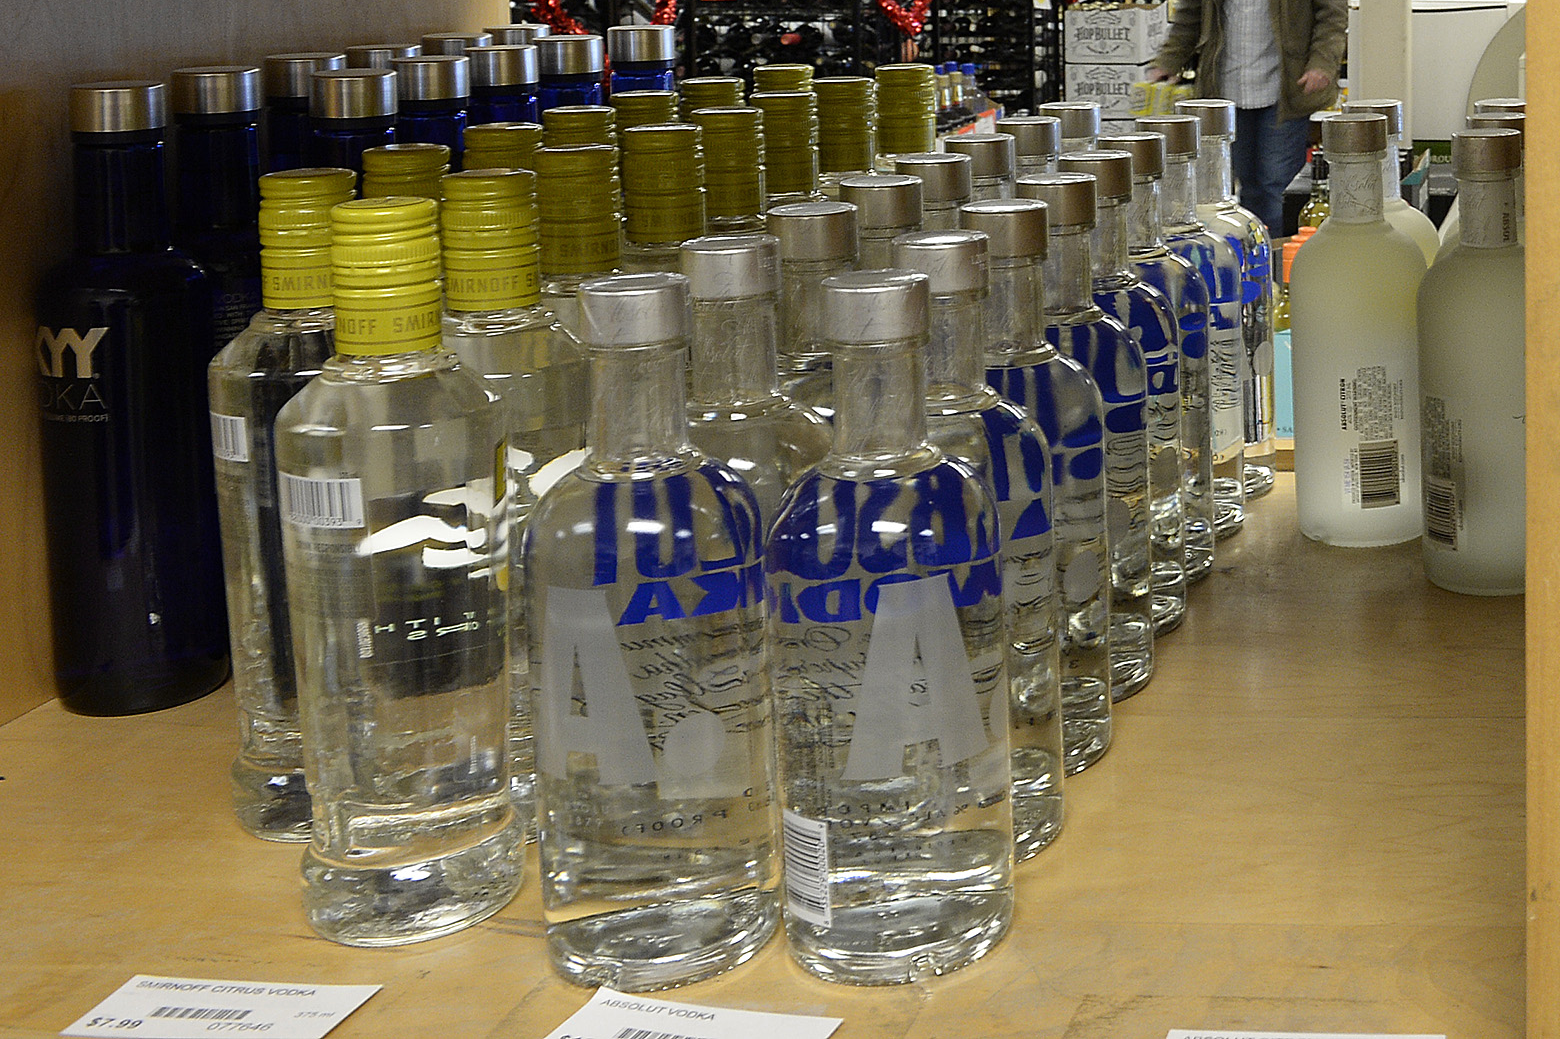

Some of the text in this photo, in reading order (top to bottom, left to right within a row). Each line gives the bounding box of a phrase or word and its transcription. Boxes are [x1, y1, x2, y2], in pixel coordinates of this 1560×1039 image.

[136, 980, 316, 997] SMIRNOFF CITRUS VODKA
[600, 998, 716, 1021] ABSOLUT VODKA
[86, 1017, 143, 1030] $7.99
[207, 1022, 274, 1032] 077646
